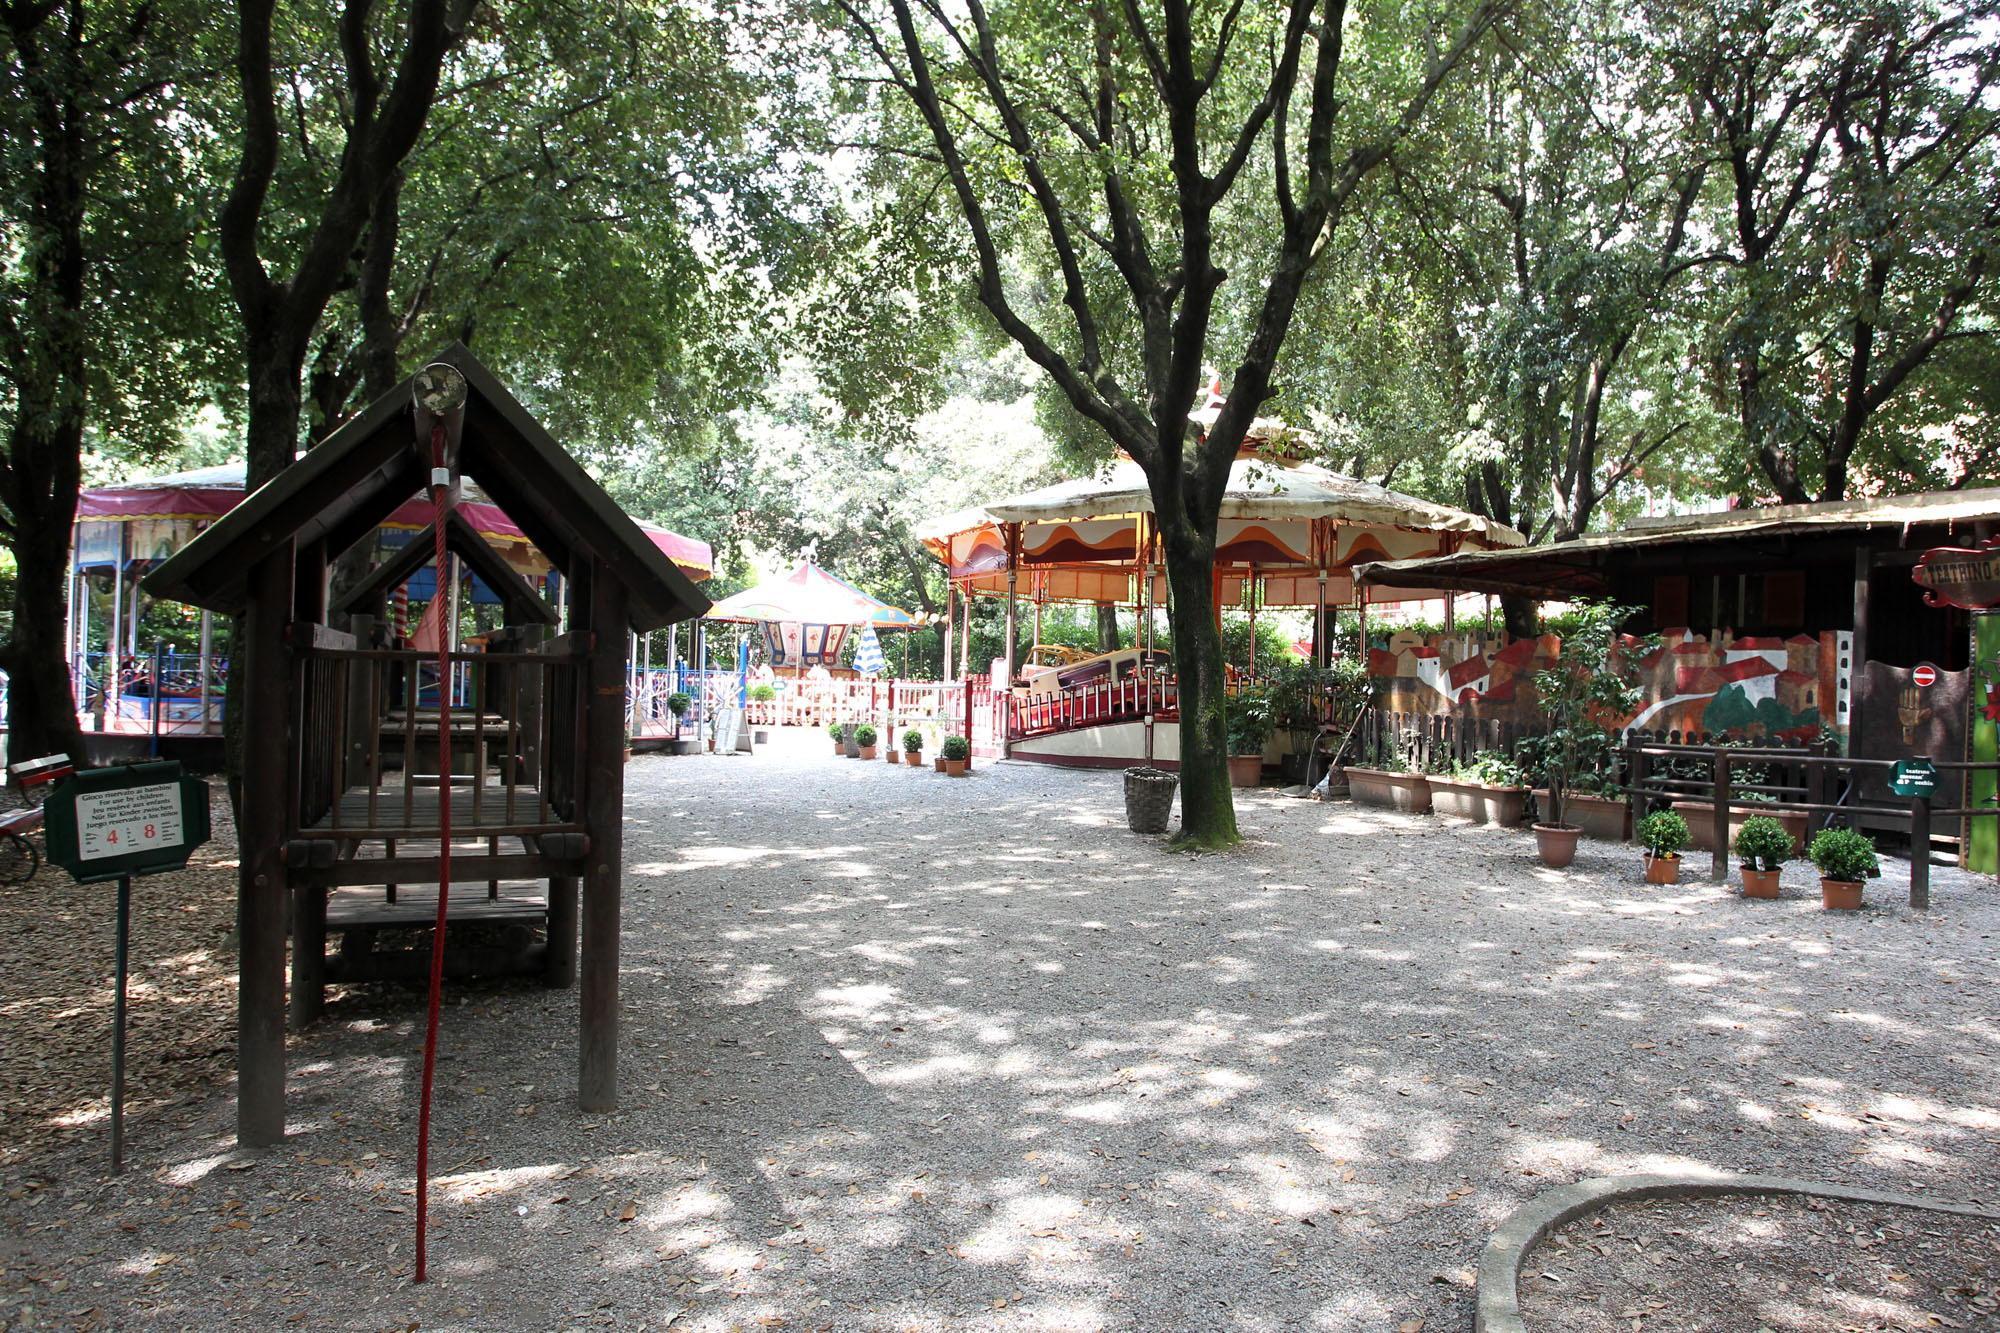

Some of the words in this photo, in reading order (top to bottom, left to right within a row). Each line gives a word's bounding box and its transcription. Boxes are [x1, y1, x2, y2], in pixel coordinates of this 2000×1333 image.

[1927, 561, 1992, 584] TEATRINO
[105, 790, 135, 799] riservato
[144, 784, 172, 793] bambini
[136, 793, 164, 801] children
[106, 829, 119, 844] 4
[143, 823, 156, 839] 8
